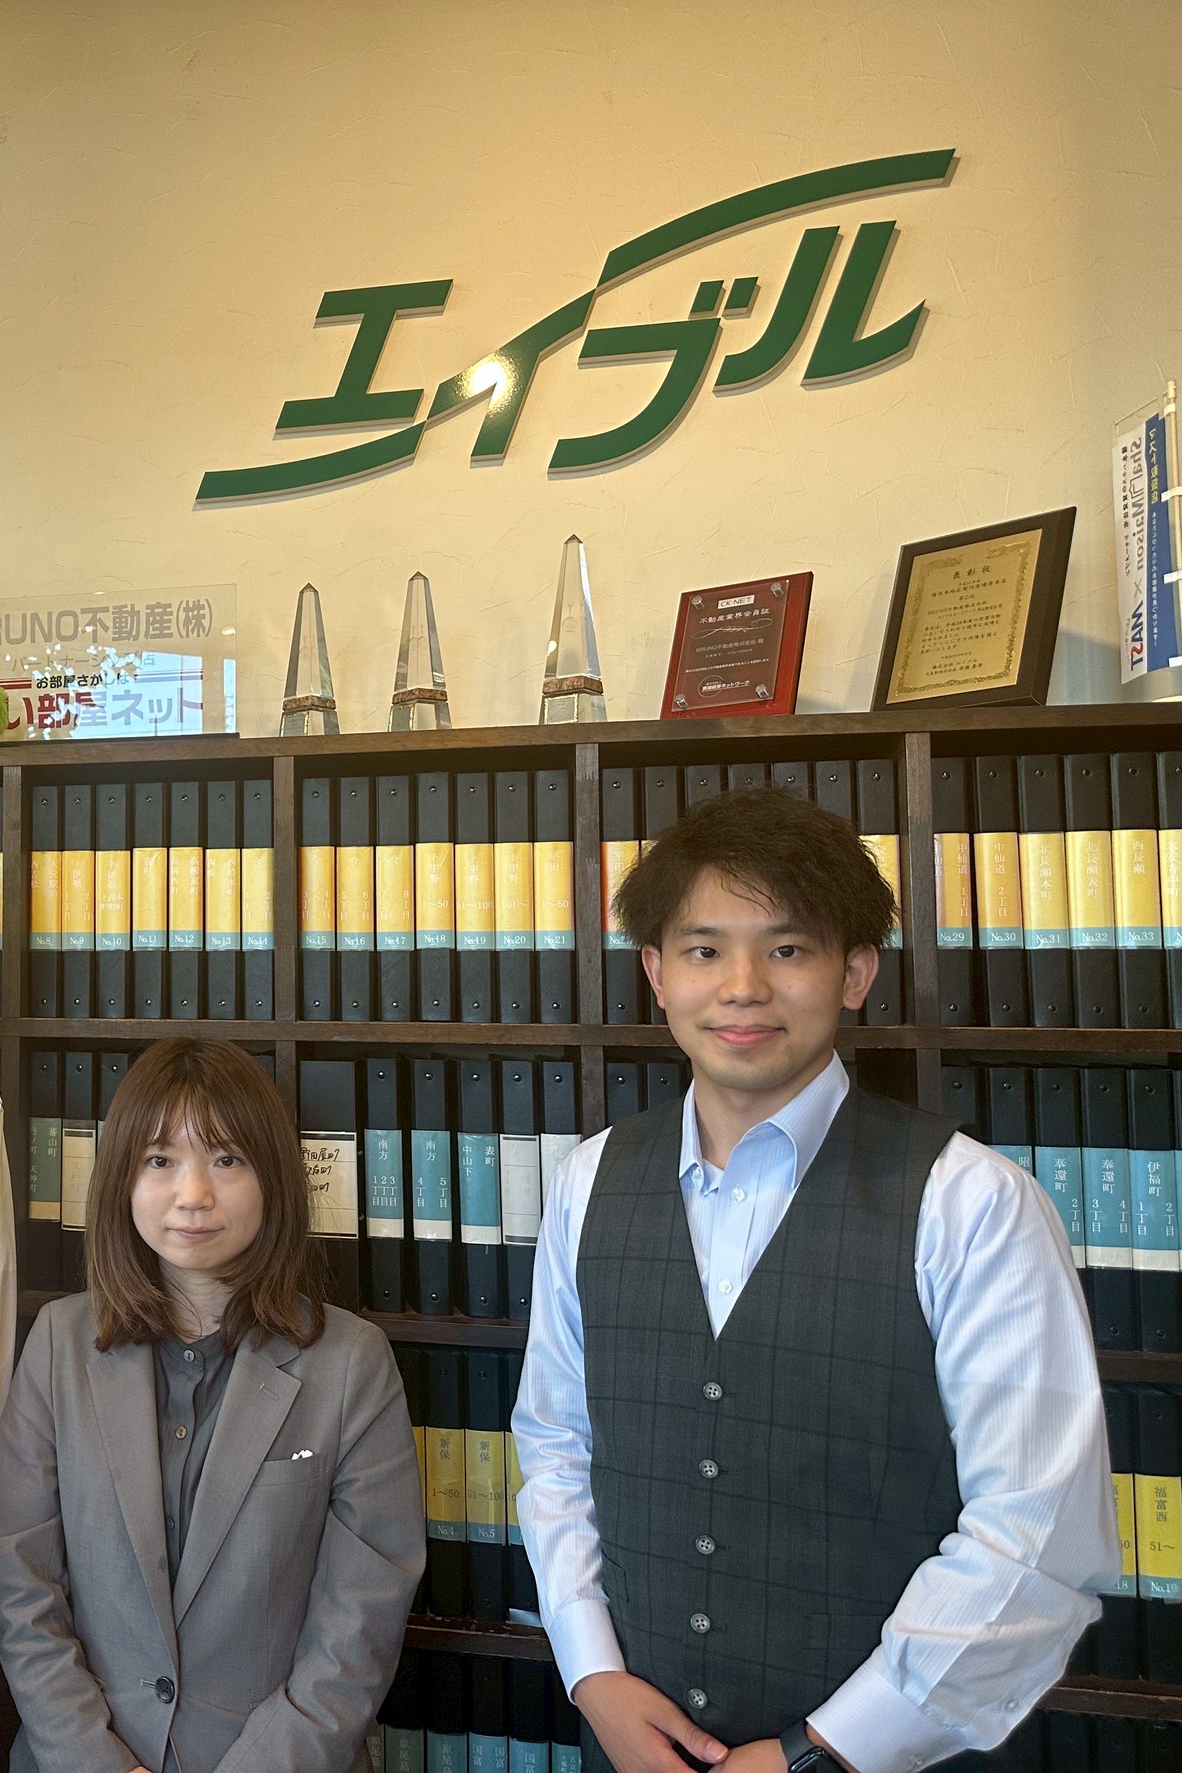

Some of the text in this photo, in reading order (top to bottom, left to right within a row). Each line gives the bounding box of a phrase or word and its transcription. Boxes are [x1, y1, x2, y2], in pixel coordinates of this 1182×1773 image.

[196, 148, 956, 501] エイブル
[1132, 840, 1146, 874] 西長瀬
[957, 843, 969, 918] 中仙道 1丁目
[993, 842, 1007, 918] 中仙道 2丁目
[36, 936, 51, 945] No.8
[69, 936, 85, 945] No.9
[102, 937, 122, 946] No.10
[138, 934, 157, 944] No.11
[174, 934, 195, 943] No.12
[211, 936, 232, 946] No.13
[247, 936, 269, 946] No.14
[305, 935, 327, 945] No.15
[384, 936, 406, 945] No.17
[424, 934, 446, 944] No.18
[463, 935, 486, 945] No.19
[503, 935, 527, 945] No.20
[544, 935, 566, 944] No.21
[939, 932, 965, 941] No.29
[990, 932, 1016, 942] No.30
[1035, 934, 1061, 944] No.31
[1081, 932, 1108, 942] No.32
[1128, 931, 1154, 941] No.33
[377, 1139, 389, 1161] 南方
[425, 1139, 437, 1162] 南方
[462, 1144, 473, 1178] 中山下
[484, 1145, 496, 1167] 表町
[1053, 1157, 1068, 1194] 奉還町
[1101, 1158, 1115, 1195] 奉還町
[1147, 1161, 1162, 1197] 伊福町
[371, 1175, 380, 1207] 1丁目
[380, 1175, 389, 1207] 2丁目
[388, 1175, 397, 1207] 3丁目
[417, 1176, 426, 1208] 4丁目
[438, 1176, 448, 1209] 5丁目
[1069, 1198, 1081, 1233] 2丁目
[1089, 1198, 1102, 1234] 3丁目
[1117, 1199, 1129, 1234] 4丁目
[1134, 1201, 1149, 1237] 1丁目
[1164, 1202, 1176, 1237] 2丁目
[439, 1438, 451, 1460] 新保
[479, 1440, 491, 1463] 新保
[1154, 1486, 1168, 1523] 福富西
[437, 1525, 455, 1536] No.4
[478, 1527, 496, 1538] No.5
[399, 1738, 410, 1772] 原尾島
[472, 1745, 483, 1767] 国富
[494, 1746, 506, 1769] 国富
